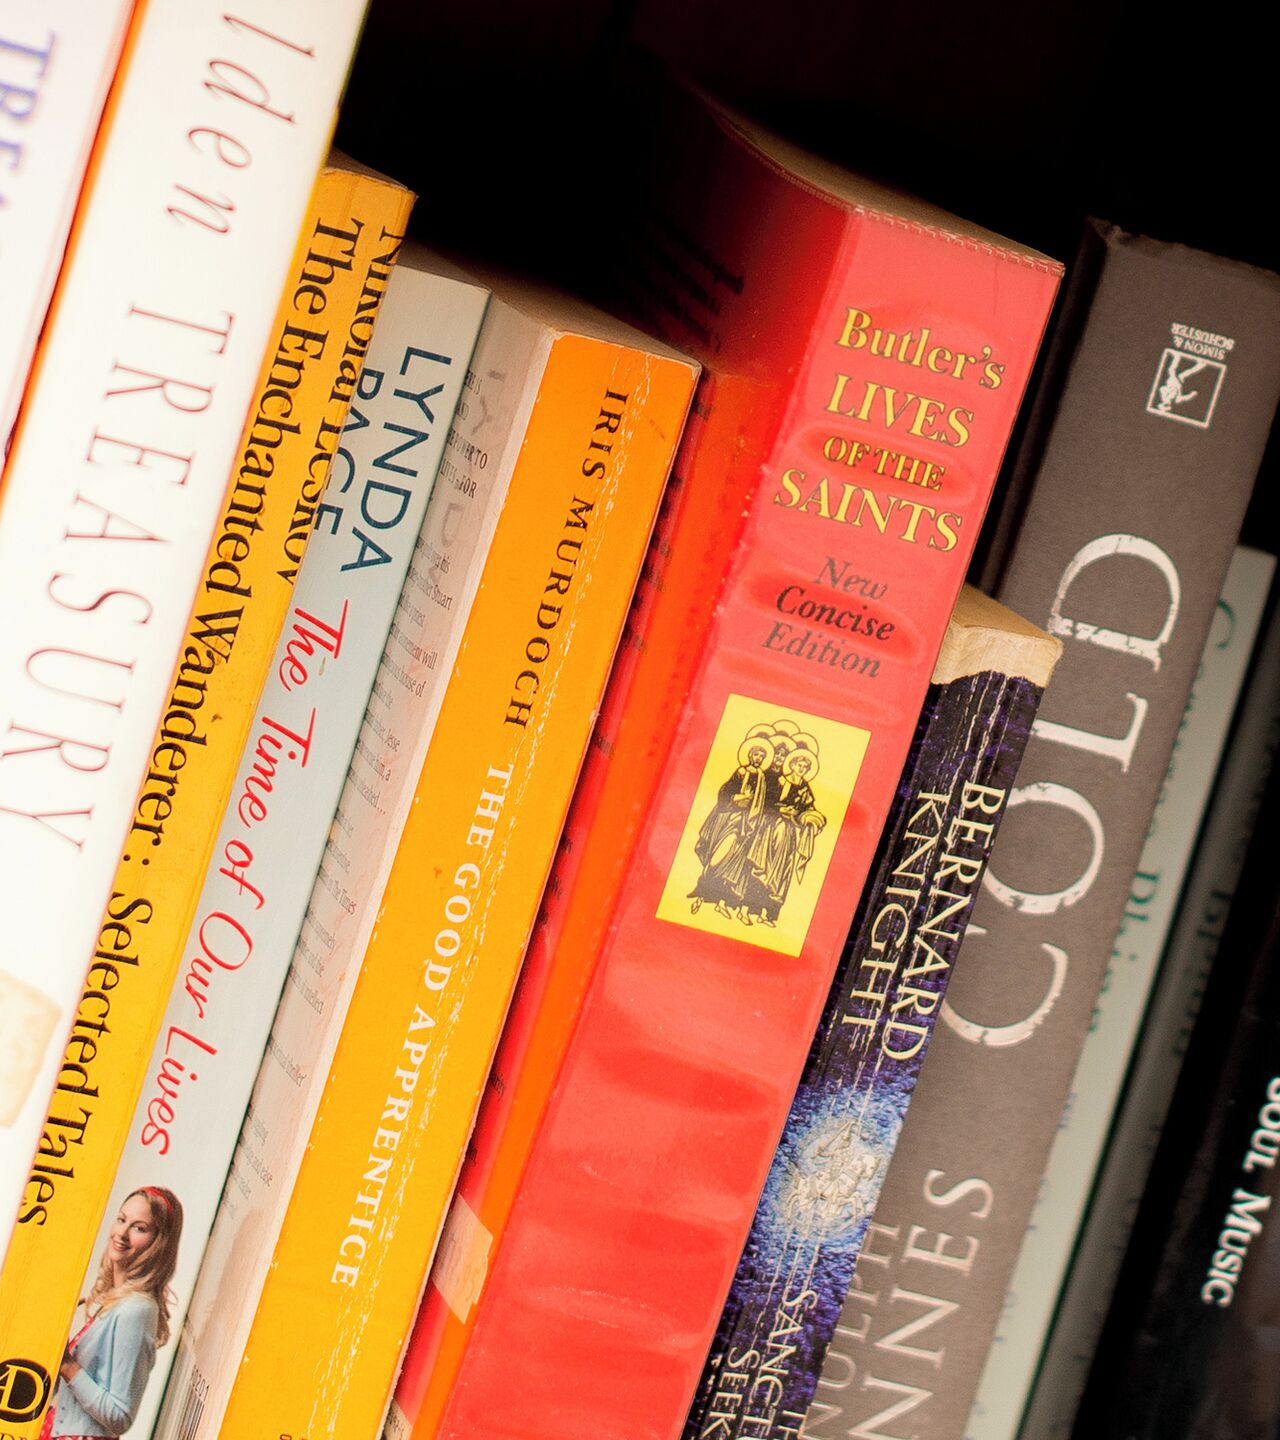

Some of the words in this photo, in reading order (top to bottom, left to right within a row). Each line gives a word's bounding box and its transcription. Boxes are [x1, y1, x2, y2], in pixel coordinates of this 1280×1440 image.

[291, 215, 365, 317] The
[836, 306, 1006, 391] Butler's
[1171, 321, 1236, 351] SCHUSTER
[203, 318, 330, 597] Enchanted
[340, 346, 453, 572] LYNDA
[581, 385, 630, 483] IRIS
[820, 435, 876, 472] OF
[873, 447, 947, 492] THE
[826, 373, 976, 452] LIVES
[773, 466, 966, 553] SAINTS
[503, 493, 596, 729] MURDOCH
[774, 585, 896, 643] Concise
[816, 556, 890, 602] New
[278, 598, 349, 692] The
[760, 618, 882, 680] Edition
[238, 706, 318, 829] Time
[467, 761, 514, 851] THE
[222, 839, 266, 910] of
[840, 789, 952, 1038] KNIGHT
[880, 780, 1007, 1063] BERNARD
[183, 910, 256, 1027] Our
[423, 861, 482, 993] GOOD
[56, 891, 154, 1114] Selected
[139, 1025, 218, 1157] Lives
[16, 1111, 87, 1228] Tales
[331, 1001, 438, 1289] APPRENTICE
